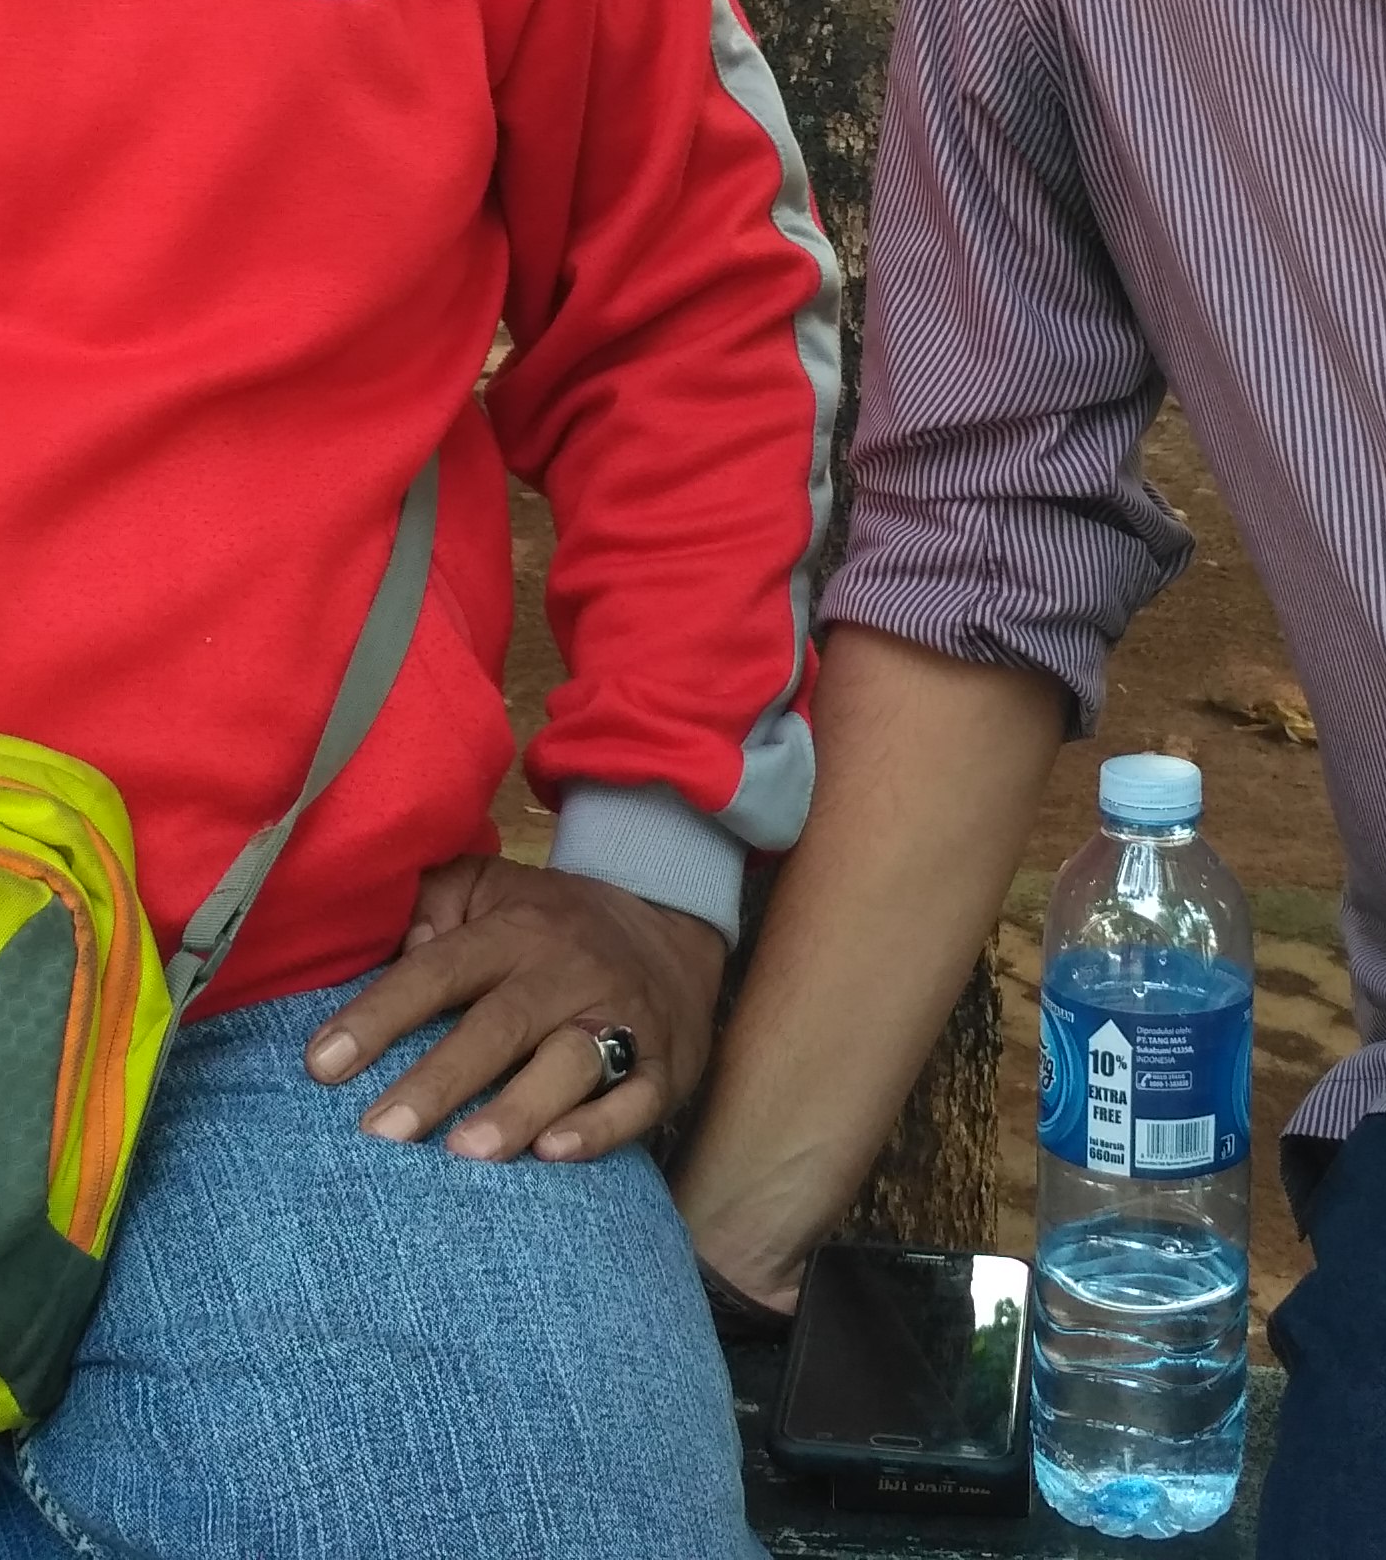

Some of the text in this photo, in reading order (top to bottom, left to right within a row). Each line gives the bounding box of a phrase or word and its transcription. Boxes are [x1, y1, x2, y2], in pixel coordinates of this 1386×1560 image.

[1089, 1048, 1128, 1078] 10%
[1088, 1084, 1128, 1106] EXTRA
[1093, 1104, 1123, 1125] FREE
[1089, 1146, 1125, 1165] 660ml
